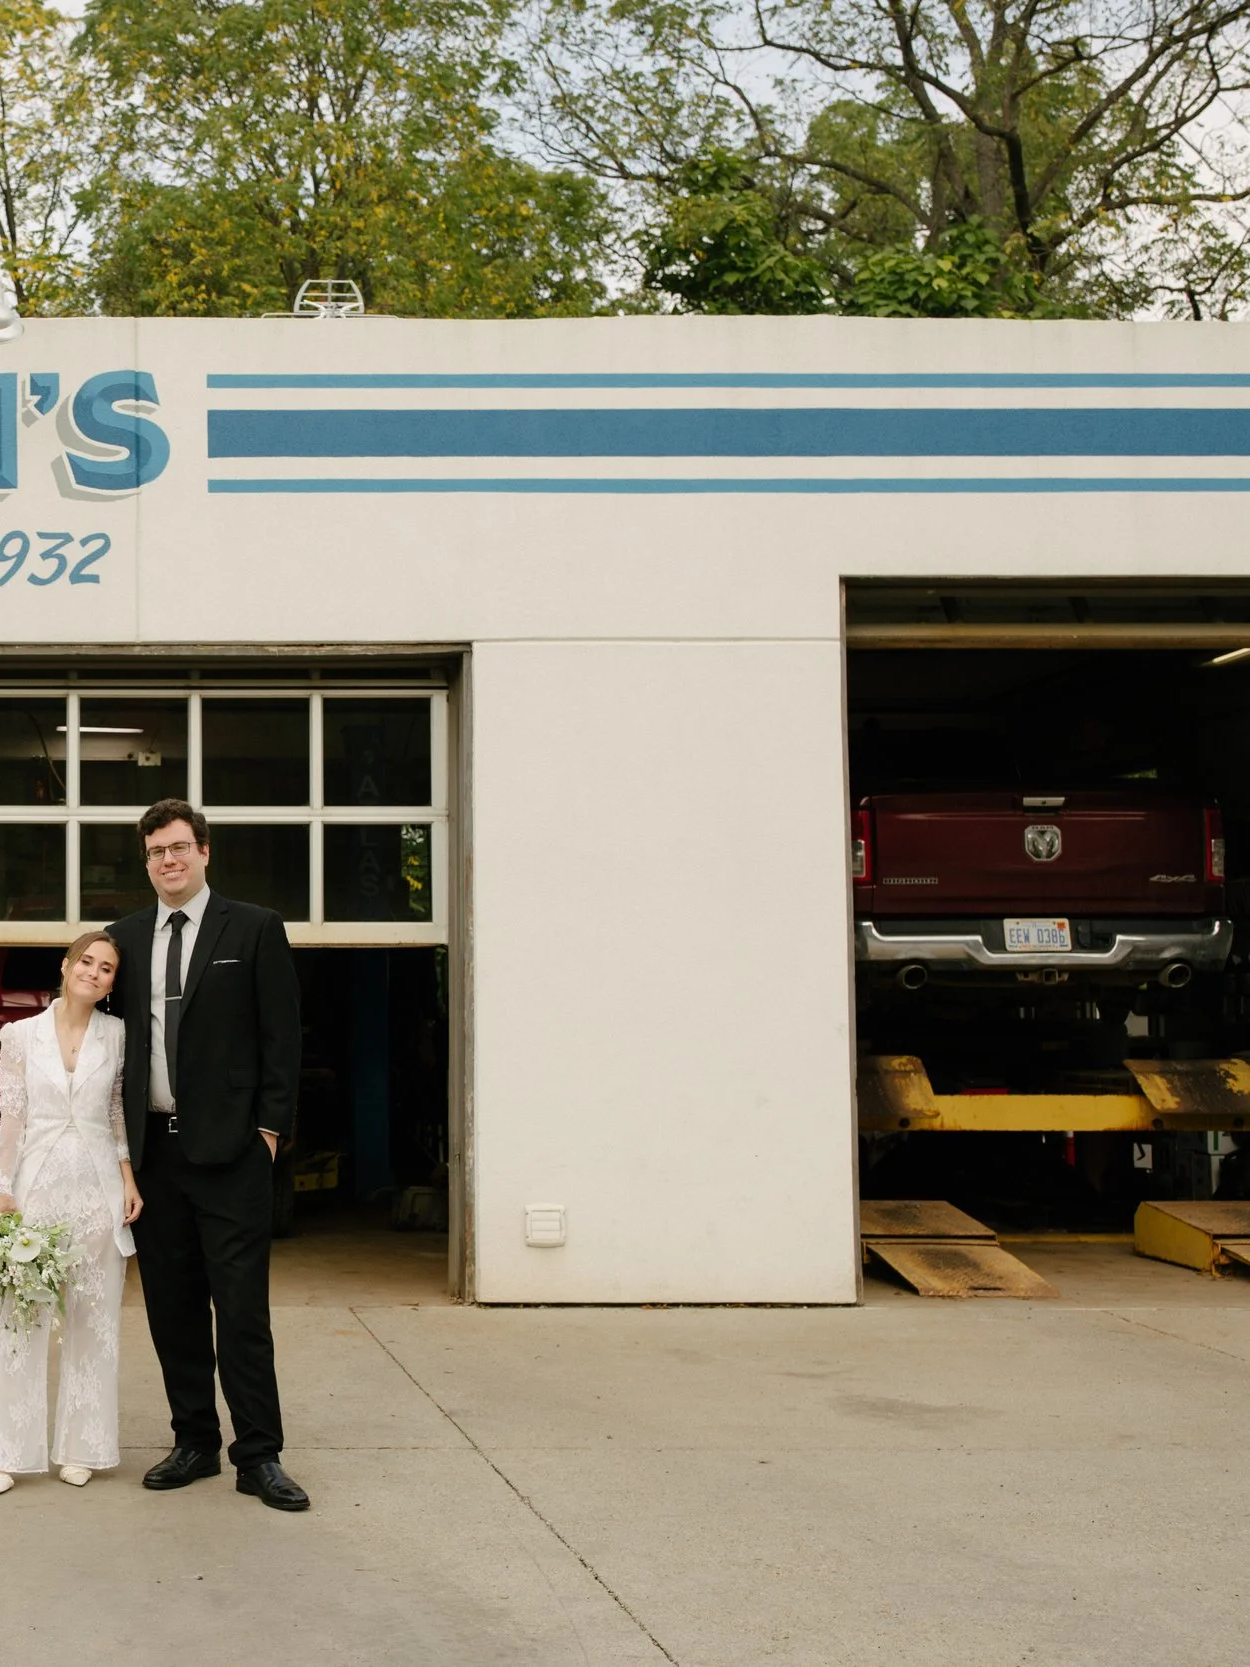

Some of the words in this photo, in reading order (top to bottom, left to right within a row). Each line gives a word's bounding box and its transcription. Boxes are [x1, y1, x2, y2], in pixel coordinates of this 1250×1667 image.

[356, 773, 381, 897] ALAS
[1009, 928, 1030, 944] EEW
[1037, 928, 1066, 944] 0386
